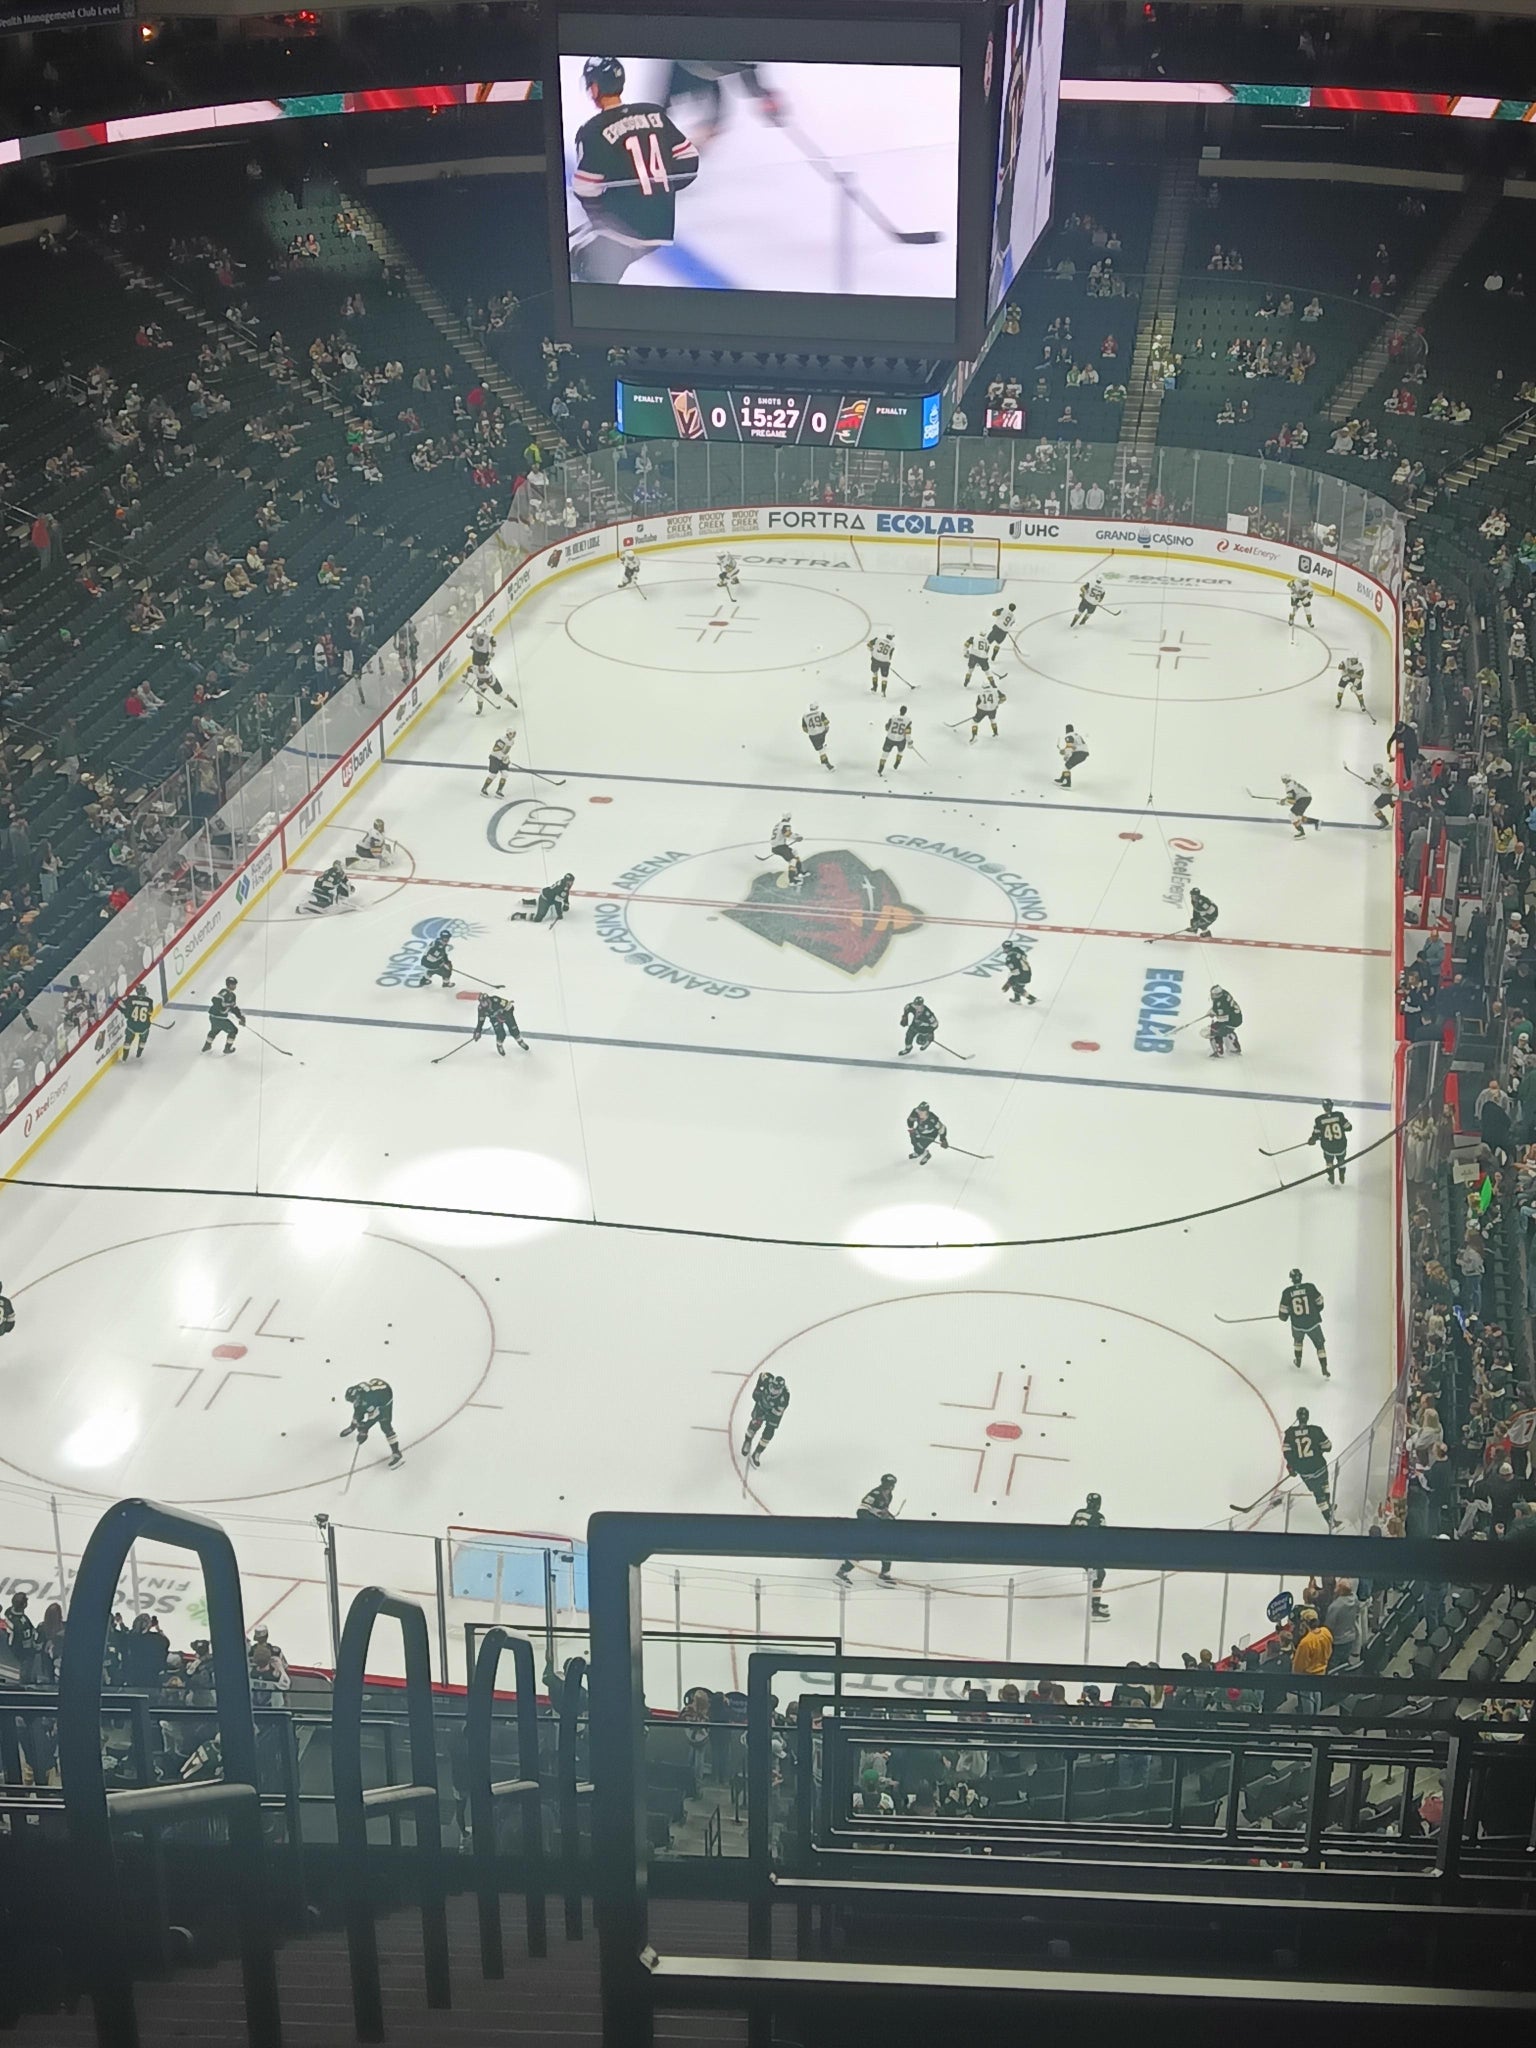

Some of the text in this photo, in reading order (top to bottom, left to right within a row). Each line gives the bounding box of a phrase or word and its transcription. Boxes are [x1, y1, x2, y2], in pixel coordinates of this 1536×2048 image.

[0, 4, 120, 27] ealth Management Club Level
[625, 133, 669, 195] 14
[633, 395, 664, 403] PENALTY
[743, 396, 750, 405] 0
[787, 398, 795, 407] 0
[711, 407, 727, 428] 0
[741, 408, 800, 428] 15:27
[876, 407, 907, 415] PENALTY
[811, 412, 827, 433] 0
[751, 429, 788, 438] PREGAME
[667, 515, 692, 525] WOODY
[699, 512, 725, 521] WOODY
[732, 510, 759, 518] WOODY
[732, 518, 759, 527] CREEK
[768, 512, 865, 530] FORTRA
[667, 524, 692, 533] CREEK
[699, 520, 725, 530] CREEK
[876, 513, 974, 535] ECOLAB
[1025, 523, 1059, 538] UHC
[635, 535, 657, 545] YouTube
[1096, 530, 1194, 546] GRAND CASINO
[877, 642, 890, 655] 36
[982, 694, 993, 705] 14
[808, 715, 822, 729] 49
[891, 722, 906, 735] 26
[353, 739, 373, 772] bank
[507, 806, 576, 849] CHS
[611, 851, 691, 890] ARENA
[886, 834, 1048, 921] GRAND CASINO
[594, 903, 637, 953] CASINO
[376, 940, 428, 987] CASINO
[643, 963, 751, 999] GRAND
[131, 1006, 148, 1022] 46
[1134, 968, 1184, 1053] ECOLAB
[1324, 1123, 1342, 1141] 49
[1291, 1295, 1310, 1315] 61
[1295, 1436, 1314, 1458] 12
